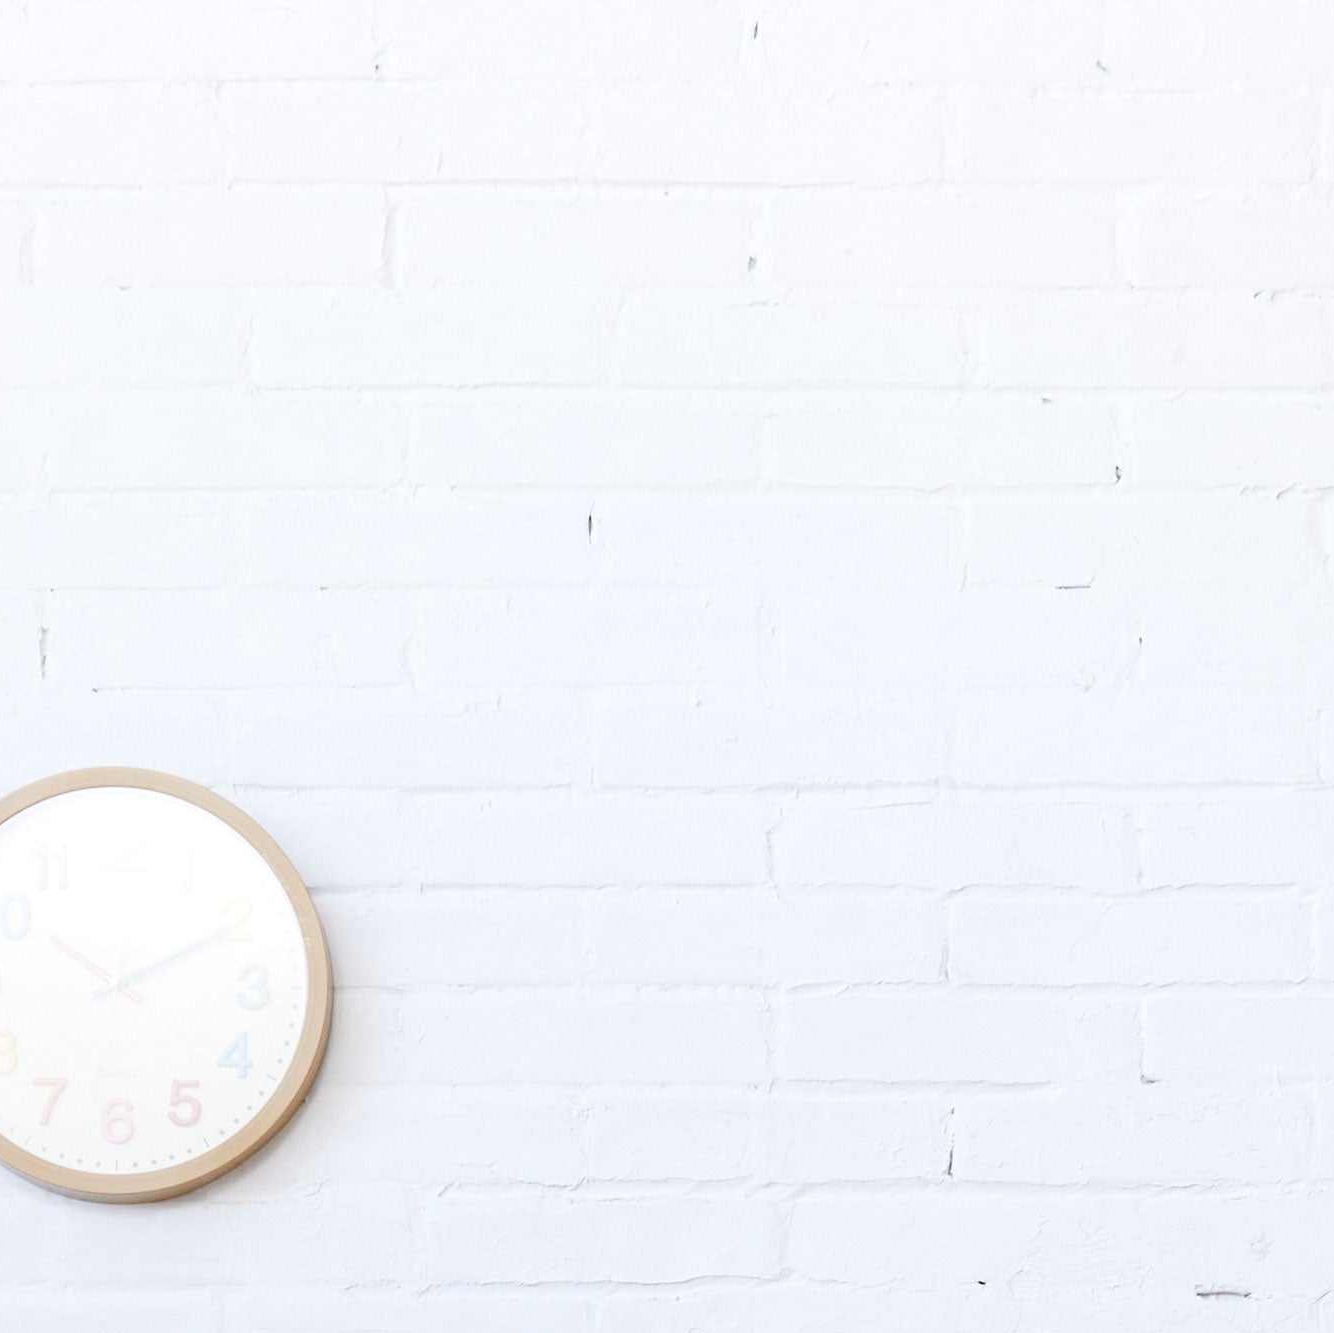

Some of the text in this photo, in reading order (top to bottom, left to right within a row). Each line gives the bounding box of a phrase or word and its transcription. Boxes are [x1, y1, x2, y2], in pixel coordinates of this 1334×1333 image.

[218, 896, 253, 943] 2
[236, 962, 271, 1010] 3
[215, 1030, 253, 1079] 4
[32, 1076, 68, 1127] 7
[100, 1096, 135, 1145] 6
[167, 1078, 203, 1128] 5
